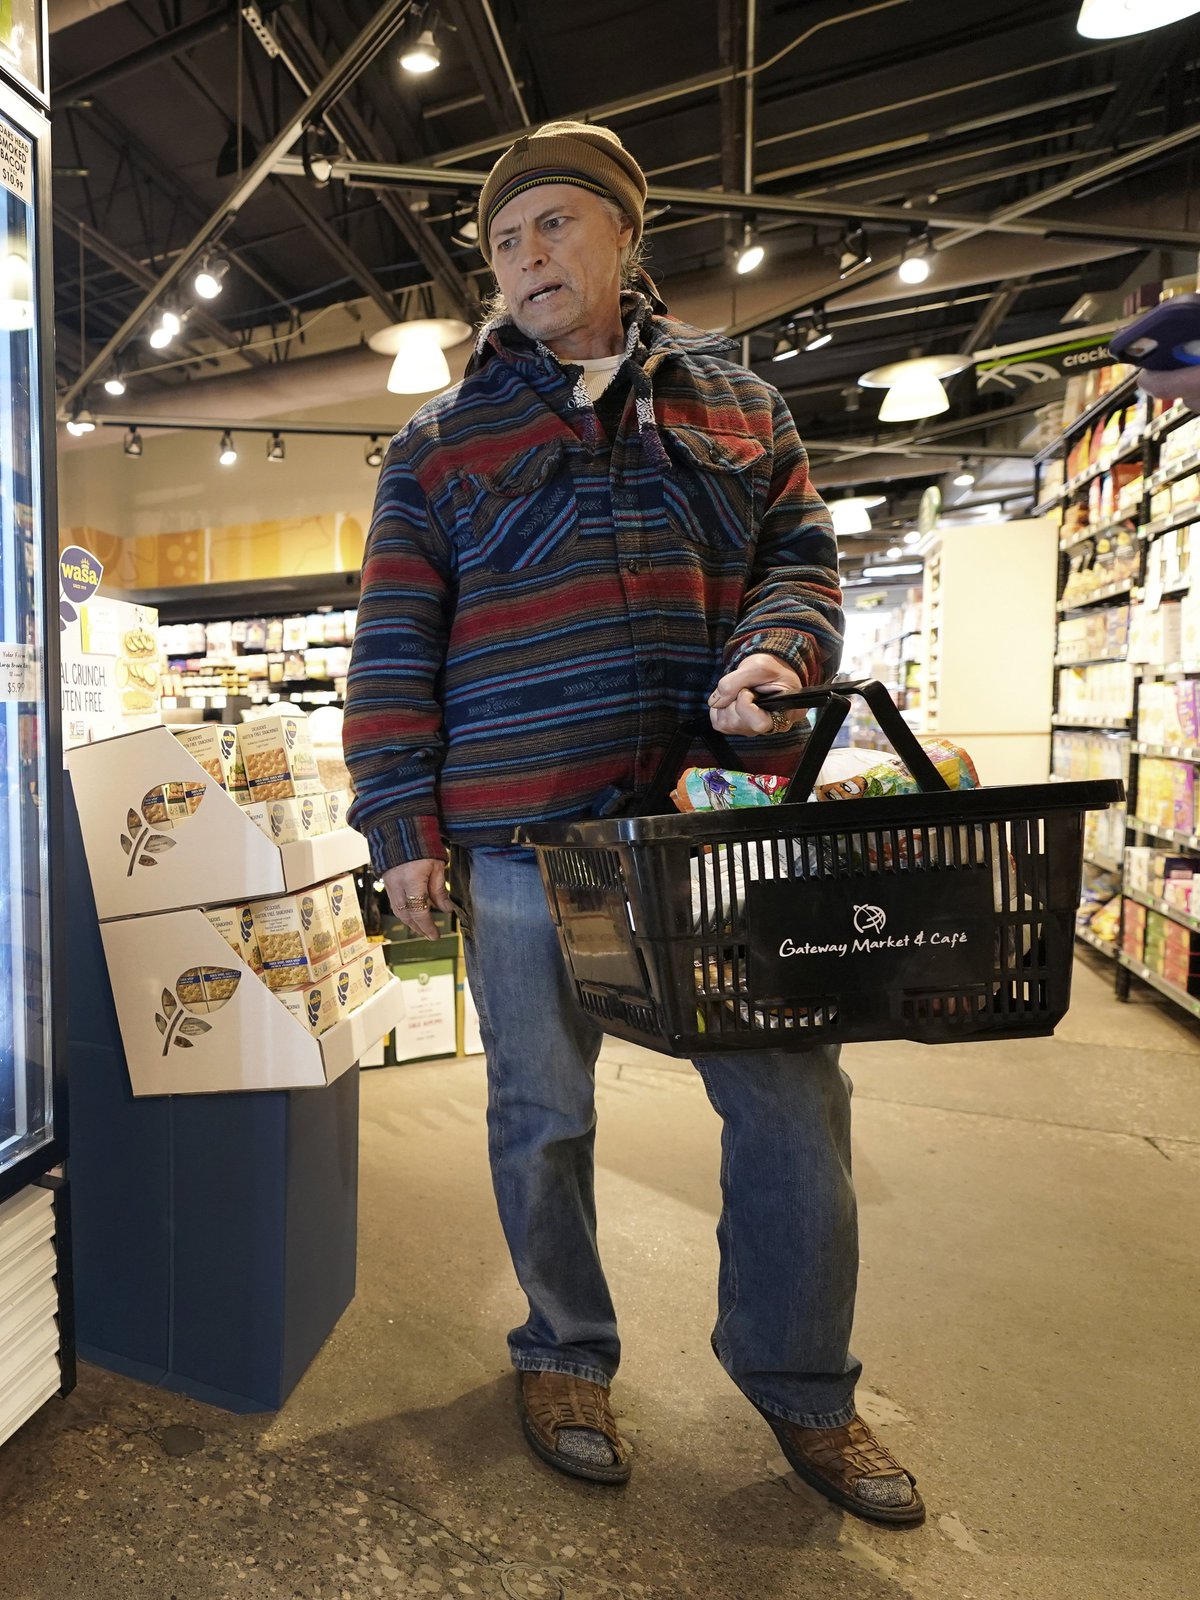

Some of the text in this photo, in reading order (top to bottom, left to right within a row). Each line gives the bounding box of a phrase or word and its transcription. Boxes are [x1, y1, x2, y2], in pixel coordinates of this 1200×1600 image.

[14, 137, 29, 153] HEAD
[0, 148, 25, 176] BACON
[2, 168, 24, 191] $10.99
[61, 562, 98, 585] wasa
[72, 663, 107, 687] CRUNCH.
[8, 682, 24, 694] $5.99
[61, 690, 105, 713] UTEN FREE.
[779, 931, 968, 958] Gateway Market & Café
